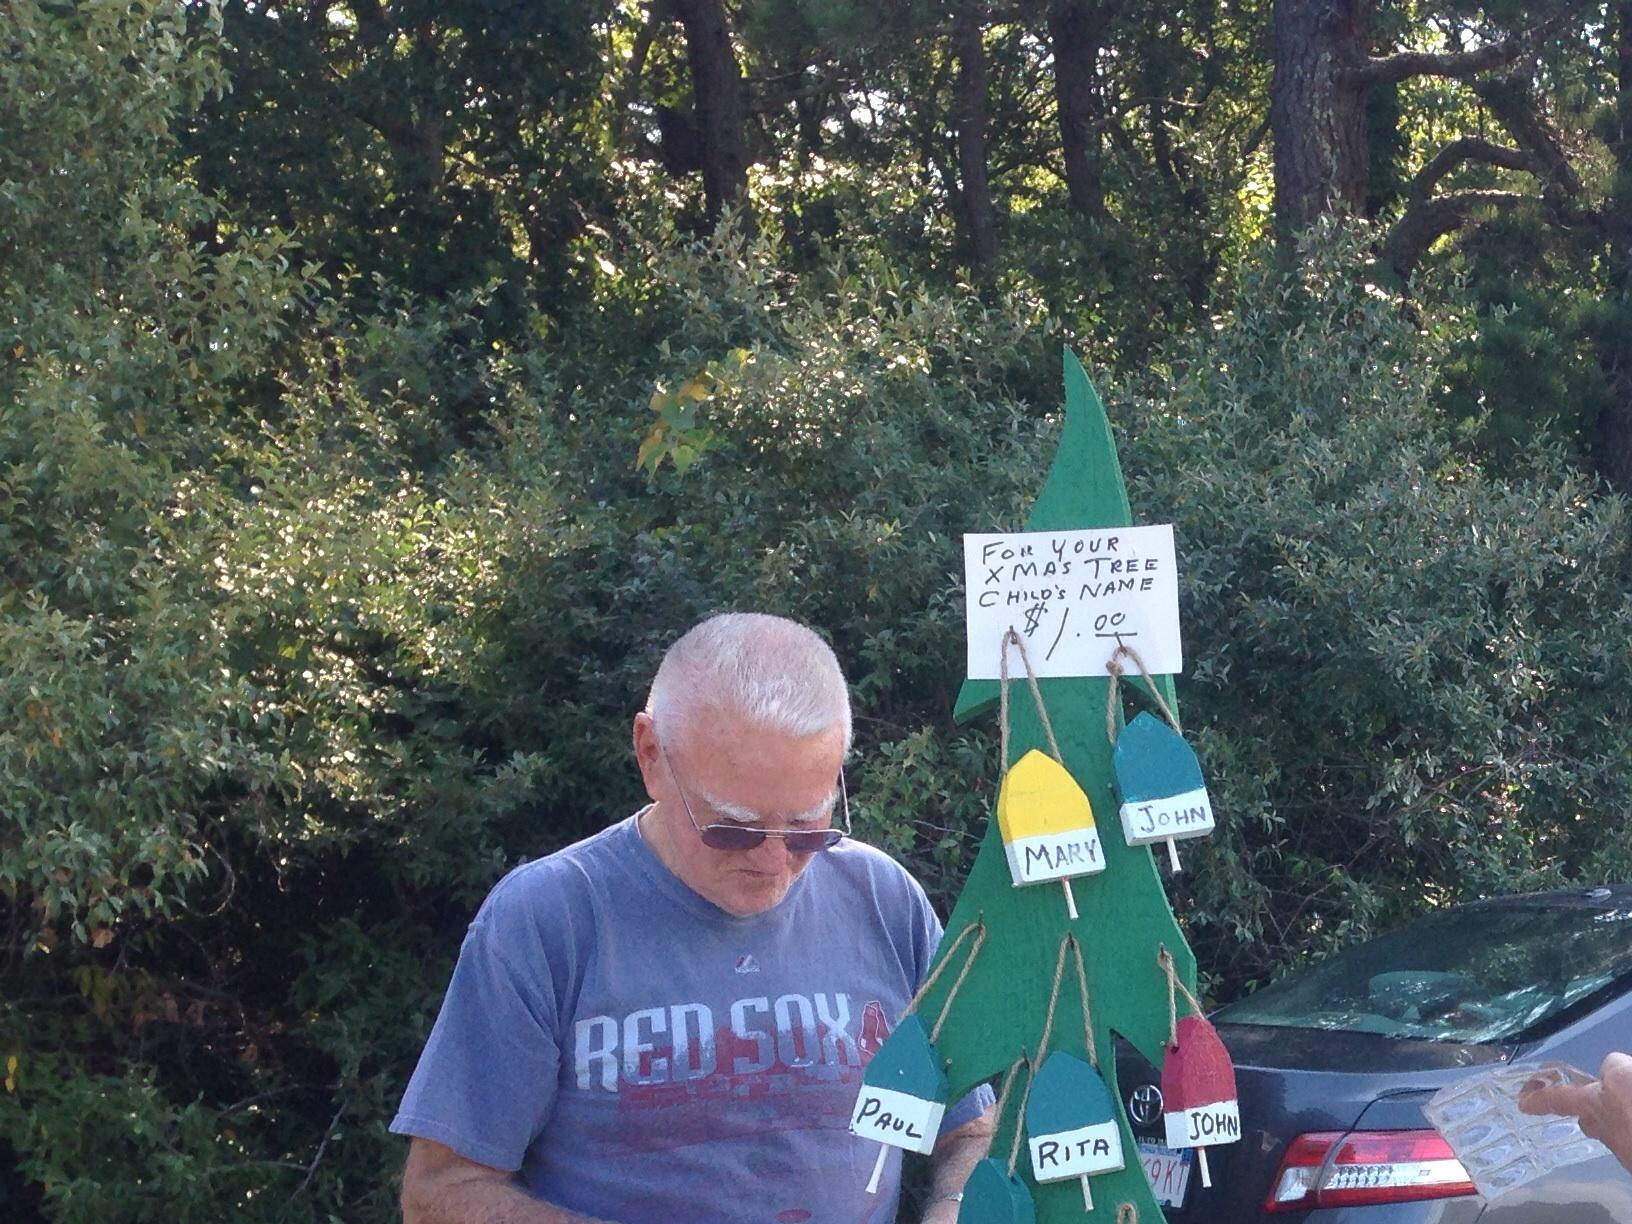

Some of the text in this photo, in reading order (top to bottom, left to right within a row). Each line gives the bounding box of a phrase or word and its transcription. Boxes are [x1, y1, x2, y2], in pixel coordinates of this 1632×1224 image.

[982, 536, 1120, 565] FOR YOUR
[985, 557, 1159, 585] XMAS TREE
[1079, 577, 1154, 601] NAME
[1137, 805, 1207, 833] JOHN
[1025, 838, 1097, 876] MARY
[574, 992, 862, 1093] RED SOX
[856, 1098, 923, 1140] PAUL
[1189, 1112, 1239, 1140] JOHN
[1038, 1138, 1109, 1169] RITA
